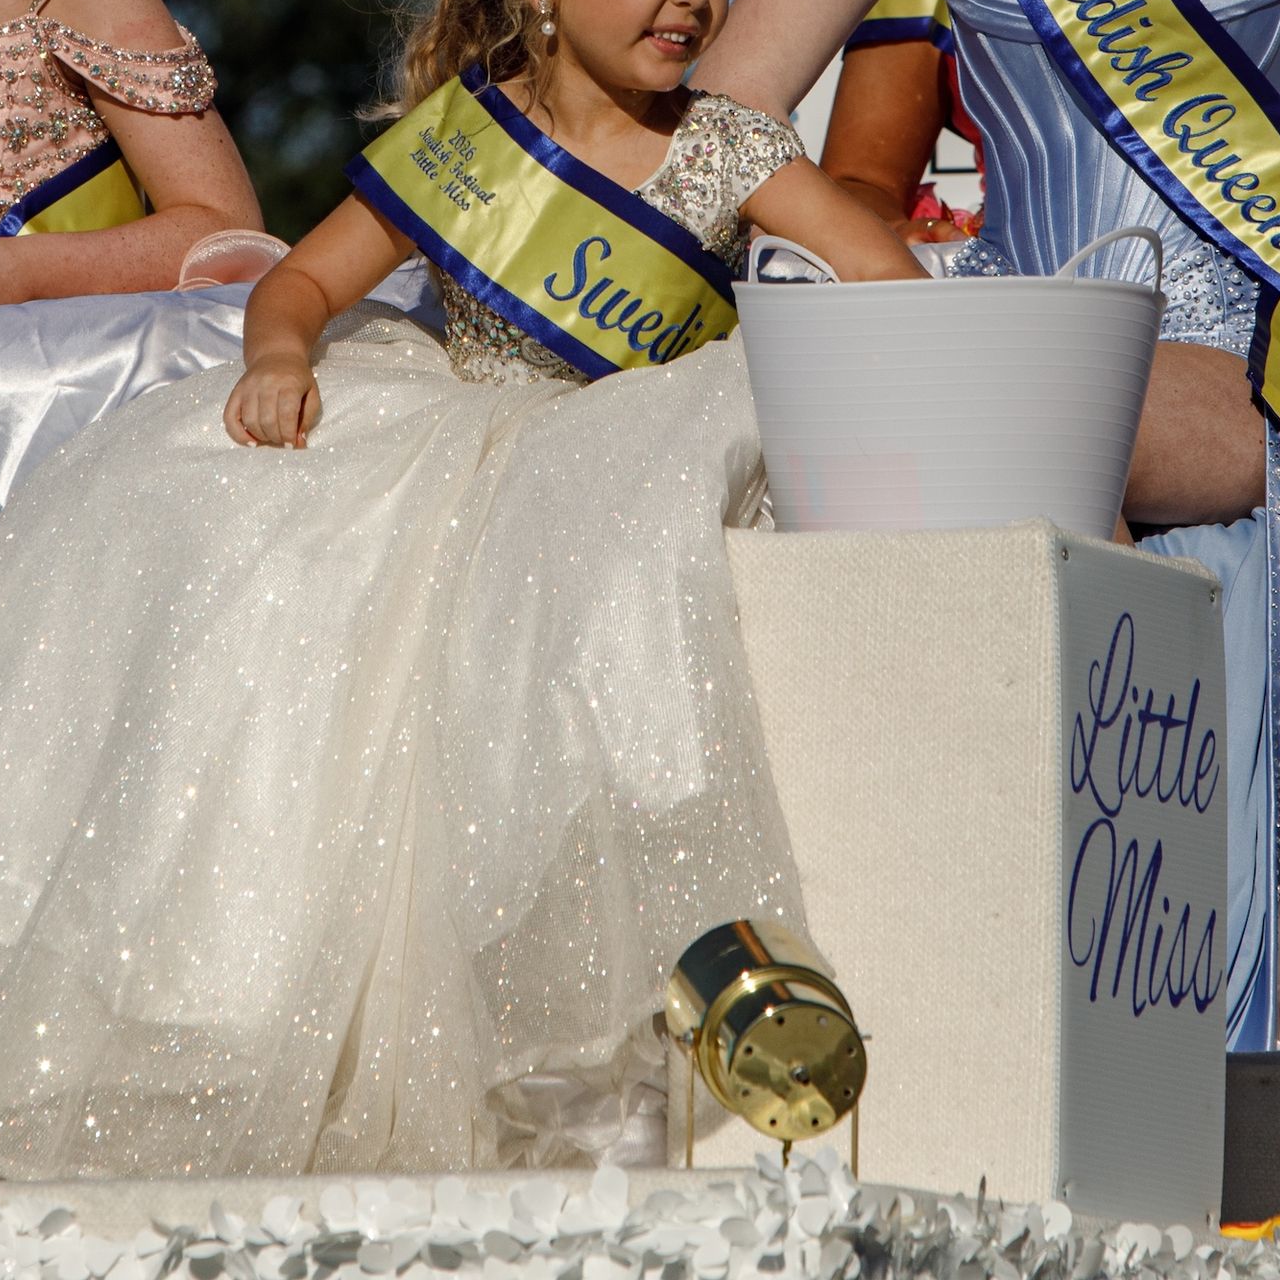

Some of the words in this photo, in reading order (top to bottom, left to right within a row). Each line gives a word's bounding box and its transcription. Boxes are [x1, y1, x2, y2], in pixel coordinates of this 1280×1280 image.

[410, 148, 439, 181] Little
[438, 181, 471, 212] Miss
[418, 126, 453, 166] Swedish
[449, 161, 497, 206] Festival
[448, 129, 478, 162] 2026
[543, 236, 728, 365] Swedi
[1070, 612, 1220, 819] Little
[1068, 817, 1223, 1018] Miss
